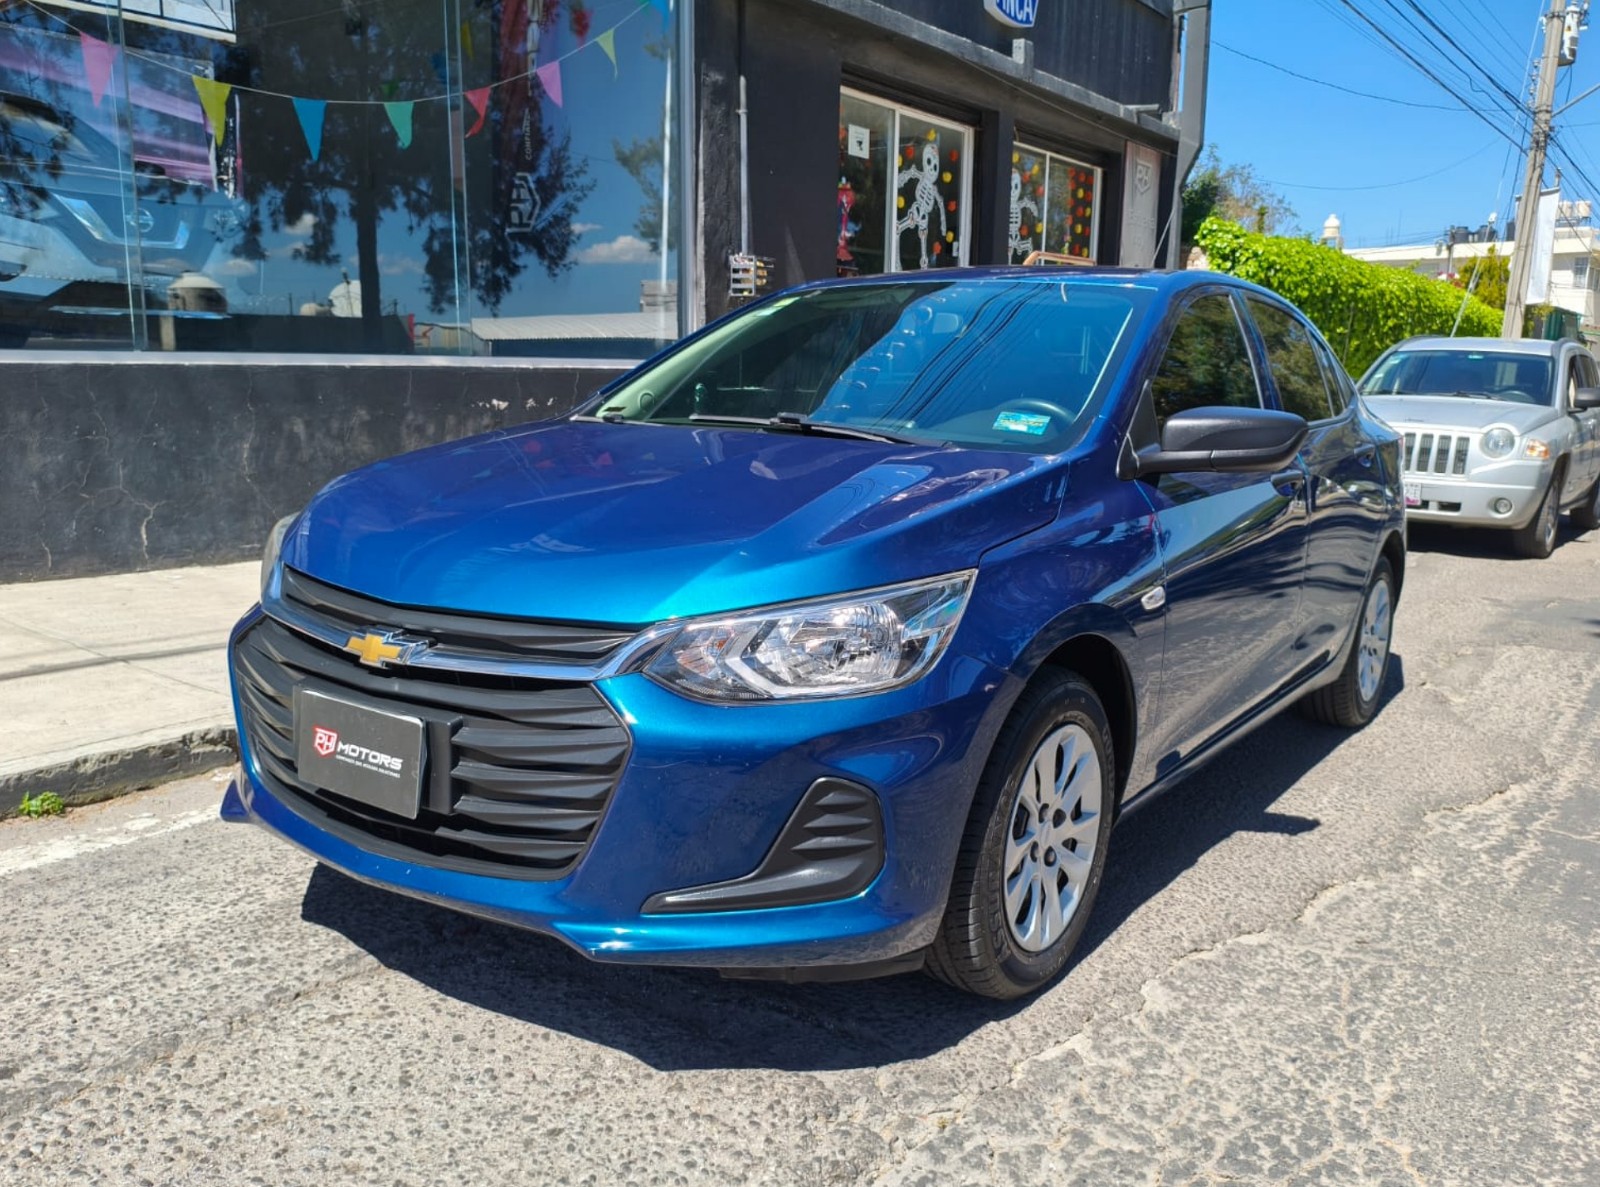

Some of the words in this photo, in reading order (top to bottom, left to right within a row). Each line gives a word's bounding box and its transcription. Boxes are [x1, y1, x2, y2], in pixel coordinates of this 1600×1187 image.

[996, 0, 1033, 21] INCA
[314, 729, 338, 754] PH
[337, 741, 403, 770] MOTORS
